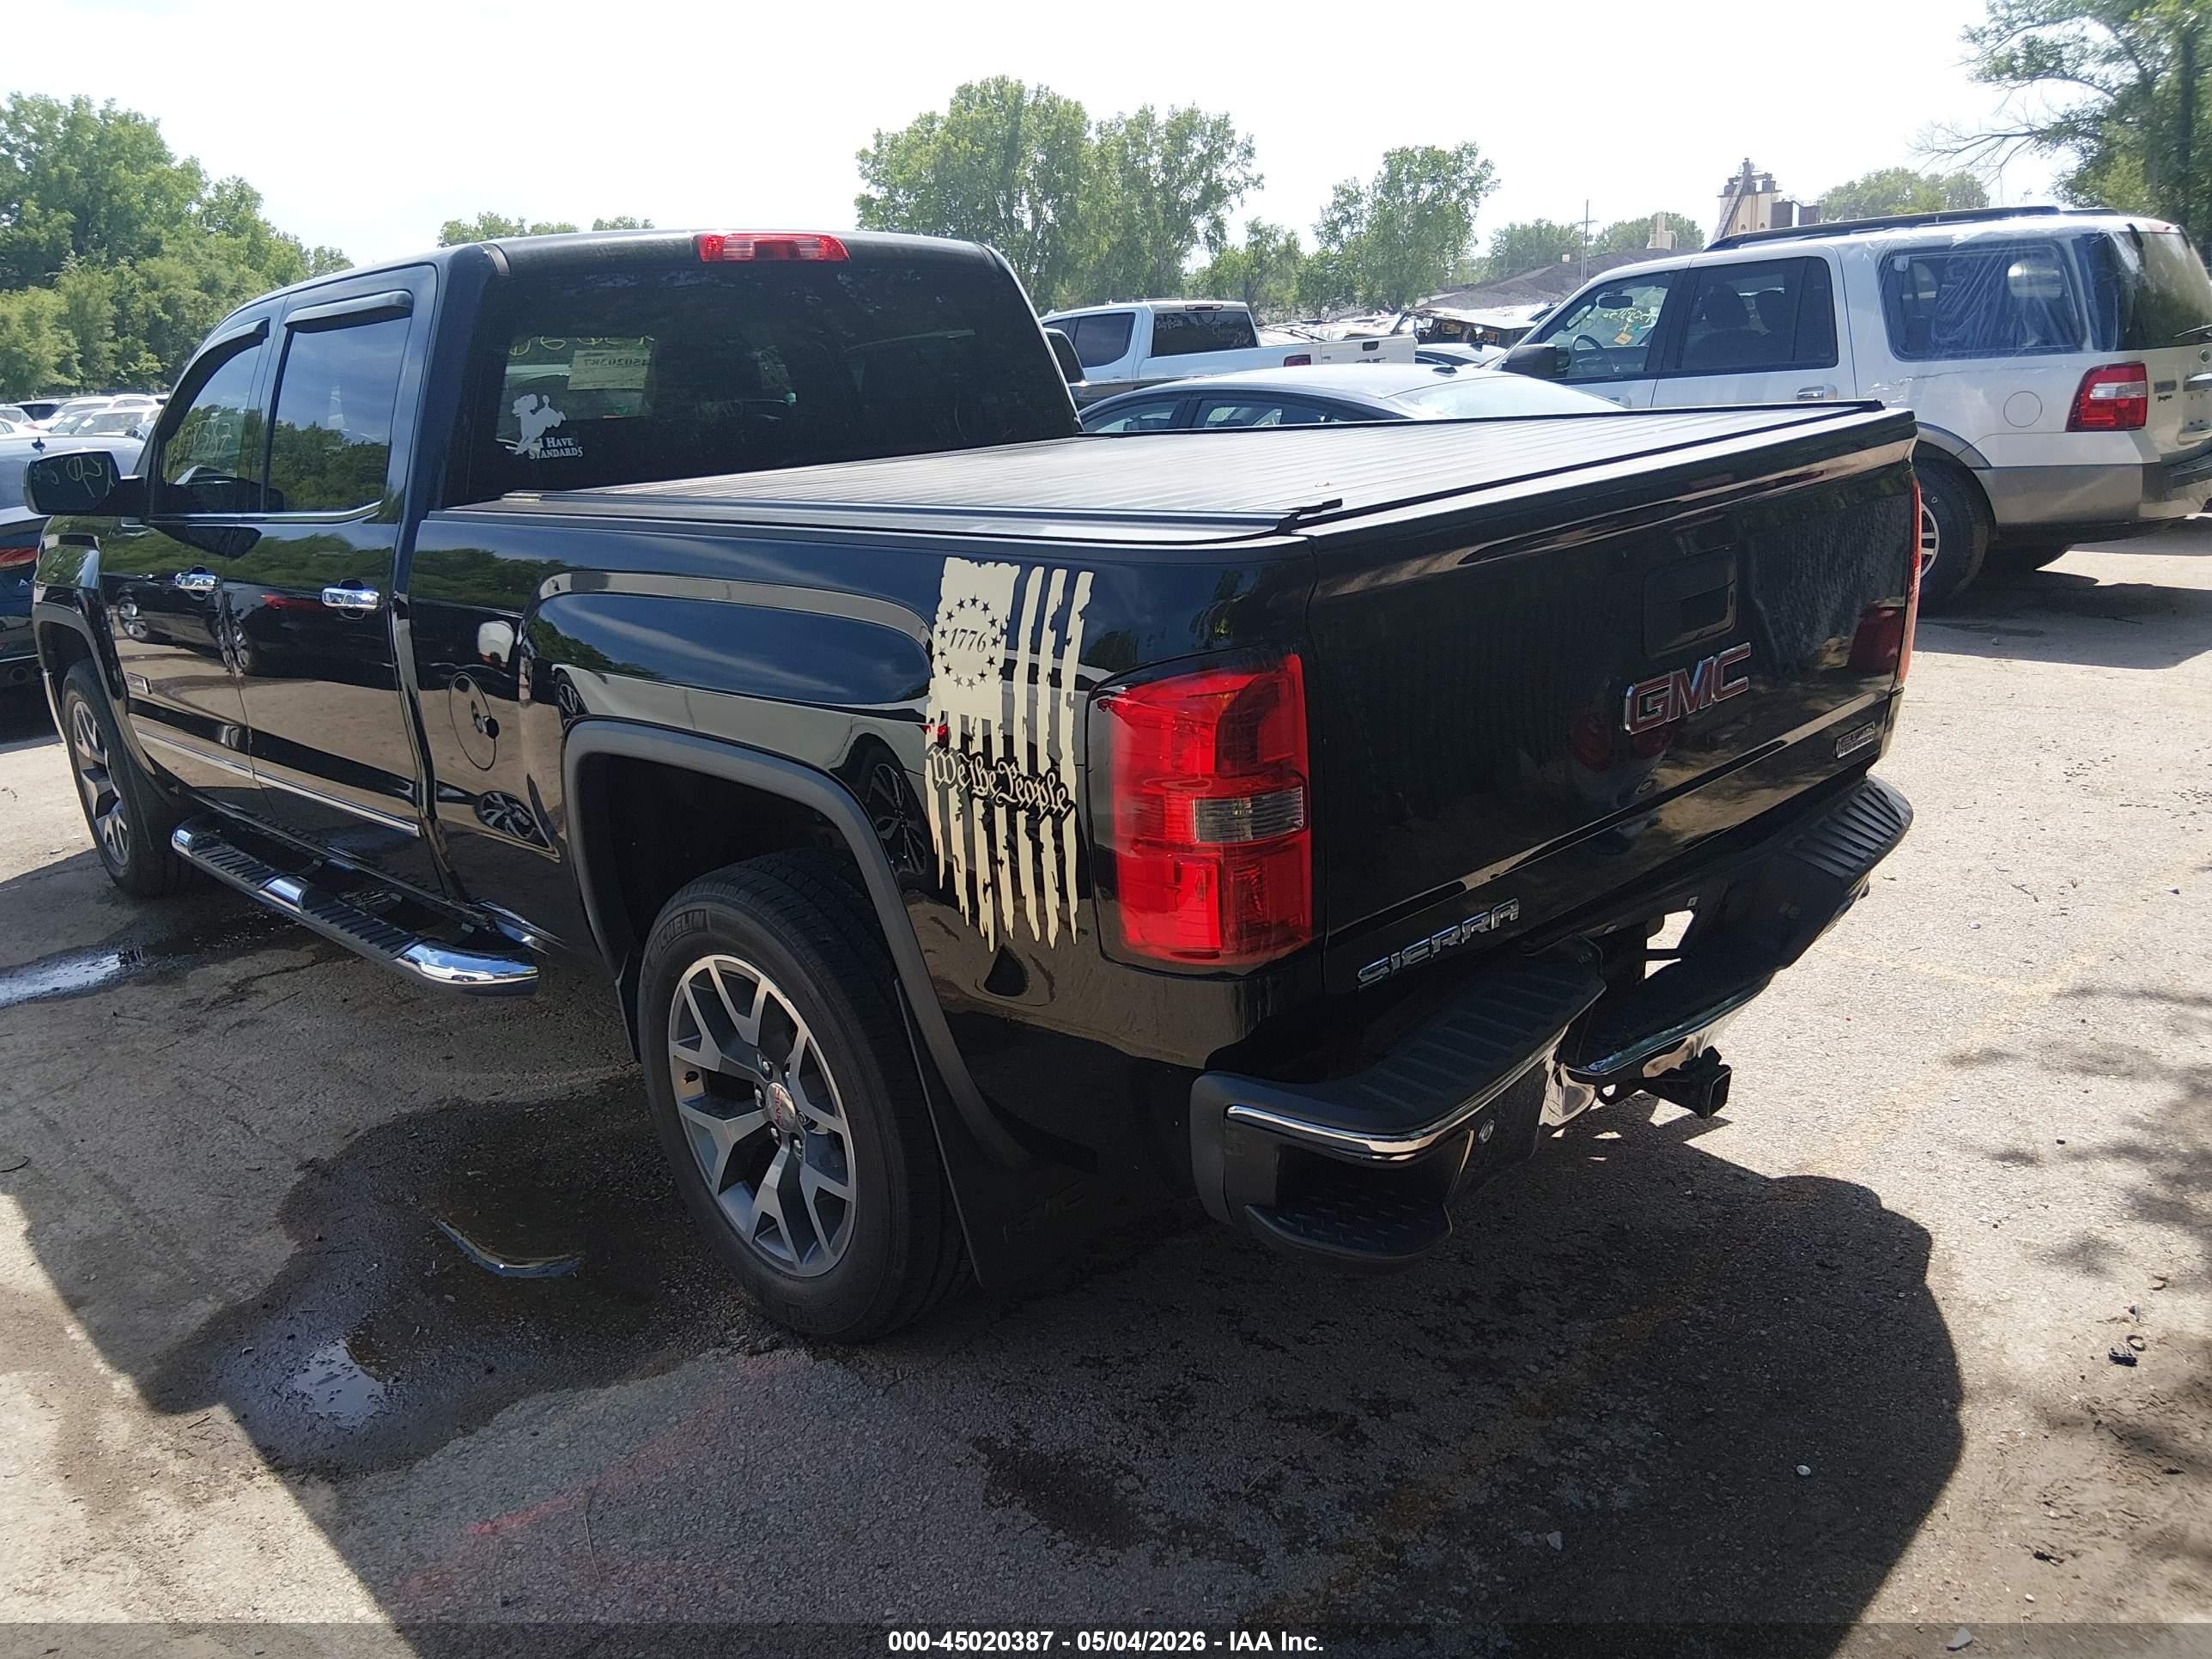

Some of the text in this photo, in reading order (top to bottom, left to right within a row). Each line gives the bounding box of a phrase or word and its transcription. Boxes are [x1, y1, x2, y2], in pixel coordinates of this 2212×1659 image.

[528, 447, 584, 460] STANDARDS
[545, 437, 574, 448] HAVE
[949, 628, 987, 653] 1776
[1625, 642, 1751, 735] GMC
[928, 746, 1072, 820] We the People
[1357, 898, 1519, 990] SIERRA
